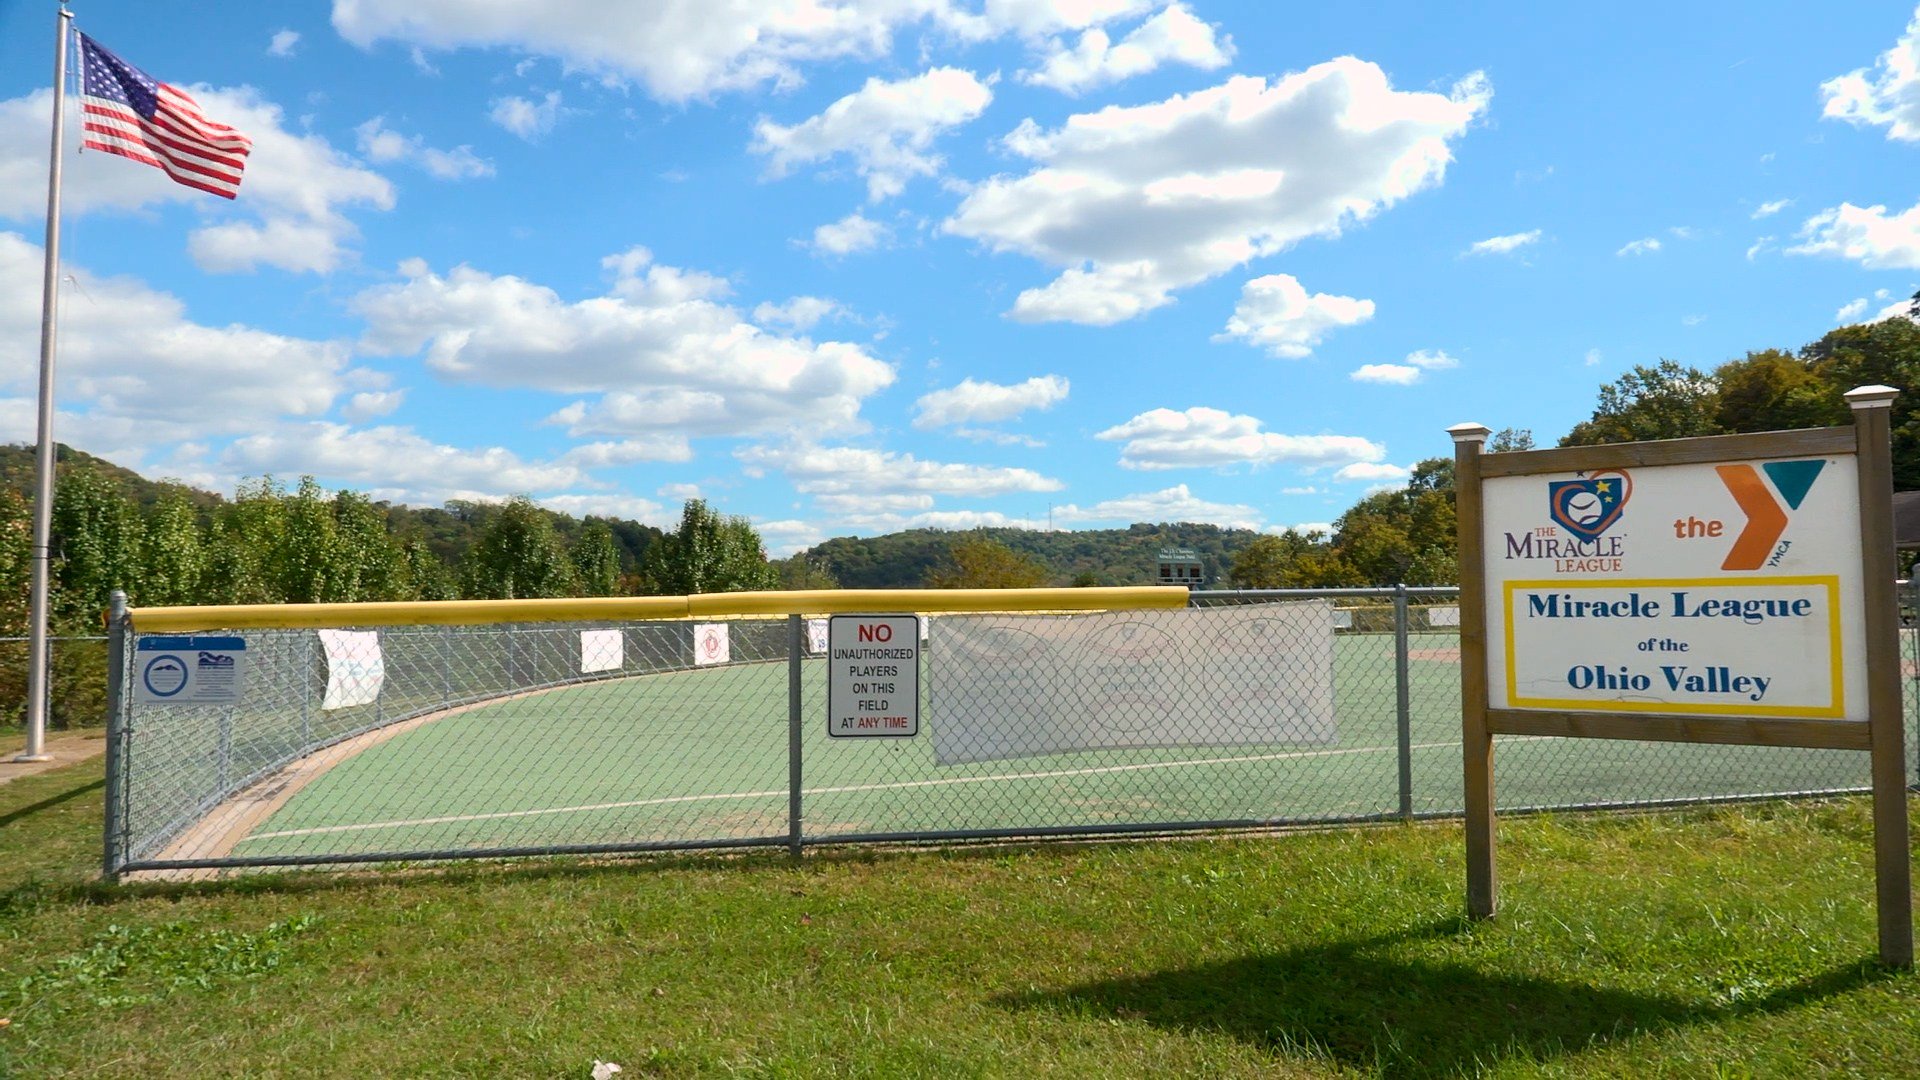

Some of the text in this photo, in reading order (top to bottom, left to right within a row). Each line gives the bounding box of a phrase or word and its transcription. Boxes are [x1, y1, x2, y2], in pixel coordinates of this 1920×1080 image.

[1535, 527, 1557, 537] THE
[1673, 516, 1723, 539] the
[1504, 532, 1625, 560] MIRACLE
[1767, 539, 1792, 568] YMCA
[1555, 559, 1623, 573] LEAGUE
[1527, 592, 1812, 626] Miracle League
[858, 624, 892, 642] NO
[1637, 638, 1690, 652] of the
[834, 648, 913, 660] UNAUTHORIZED
[849, 665, 898, 677] PLAYERS
[852, 683, 895, 694] ON THIS
[1567, 665, 1771, 701] Ohio Valley
[858, 700, 889, 711] FIELD
[841, 716, 908, 729] AT ANY TIME
